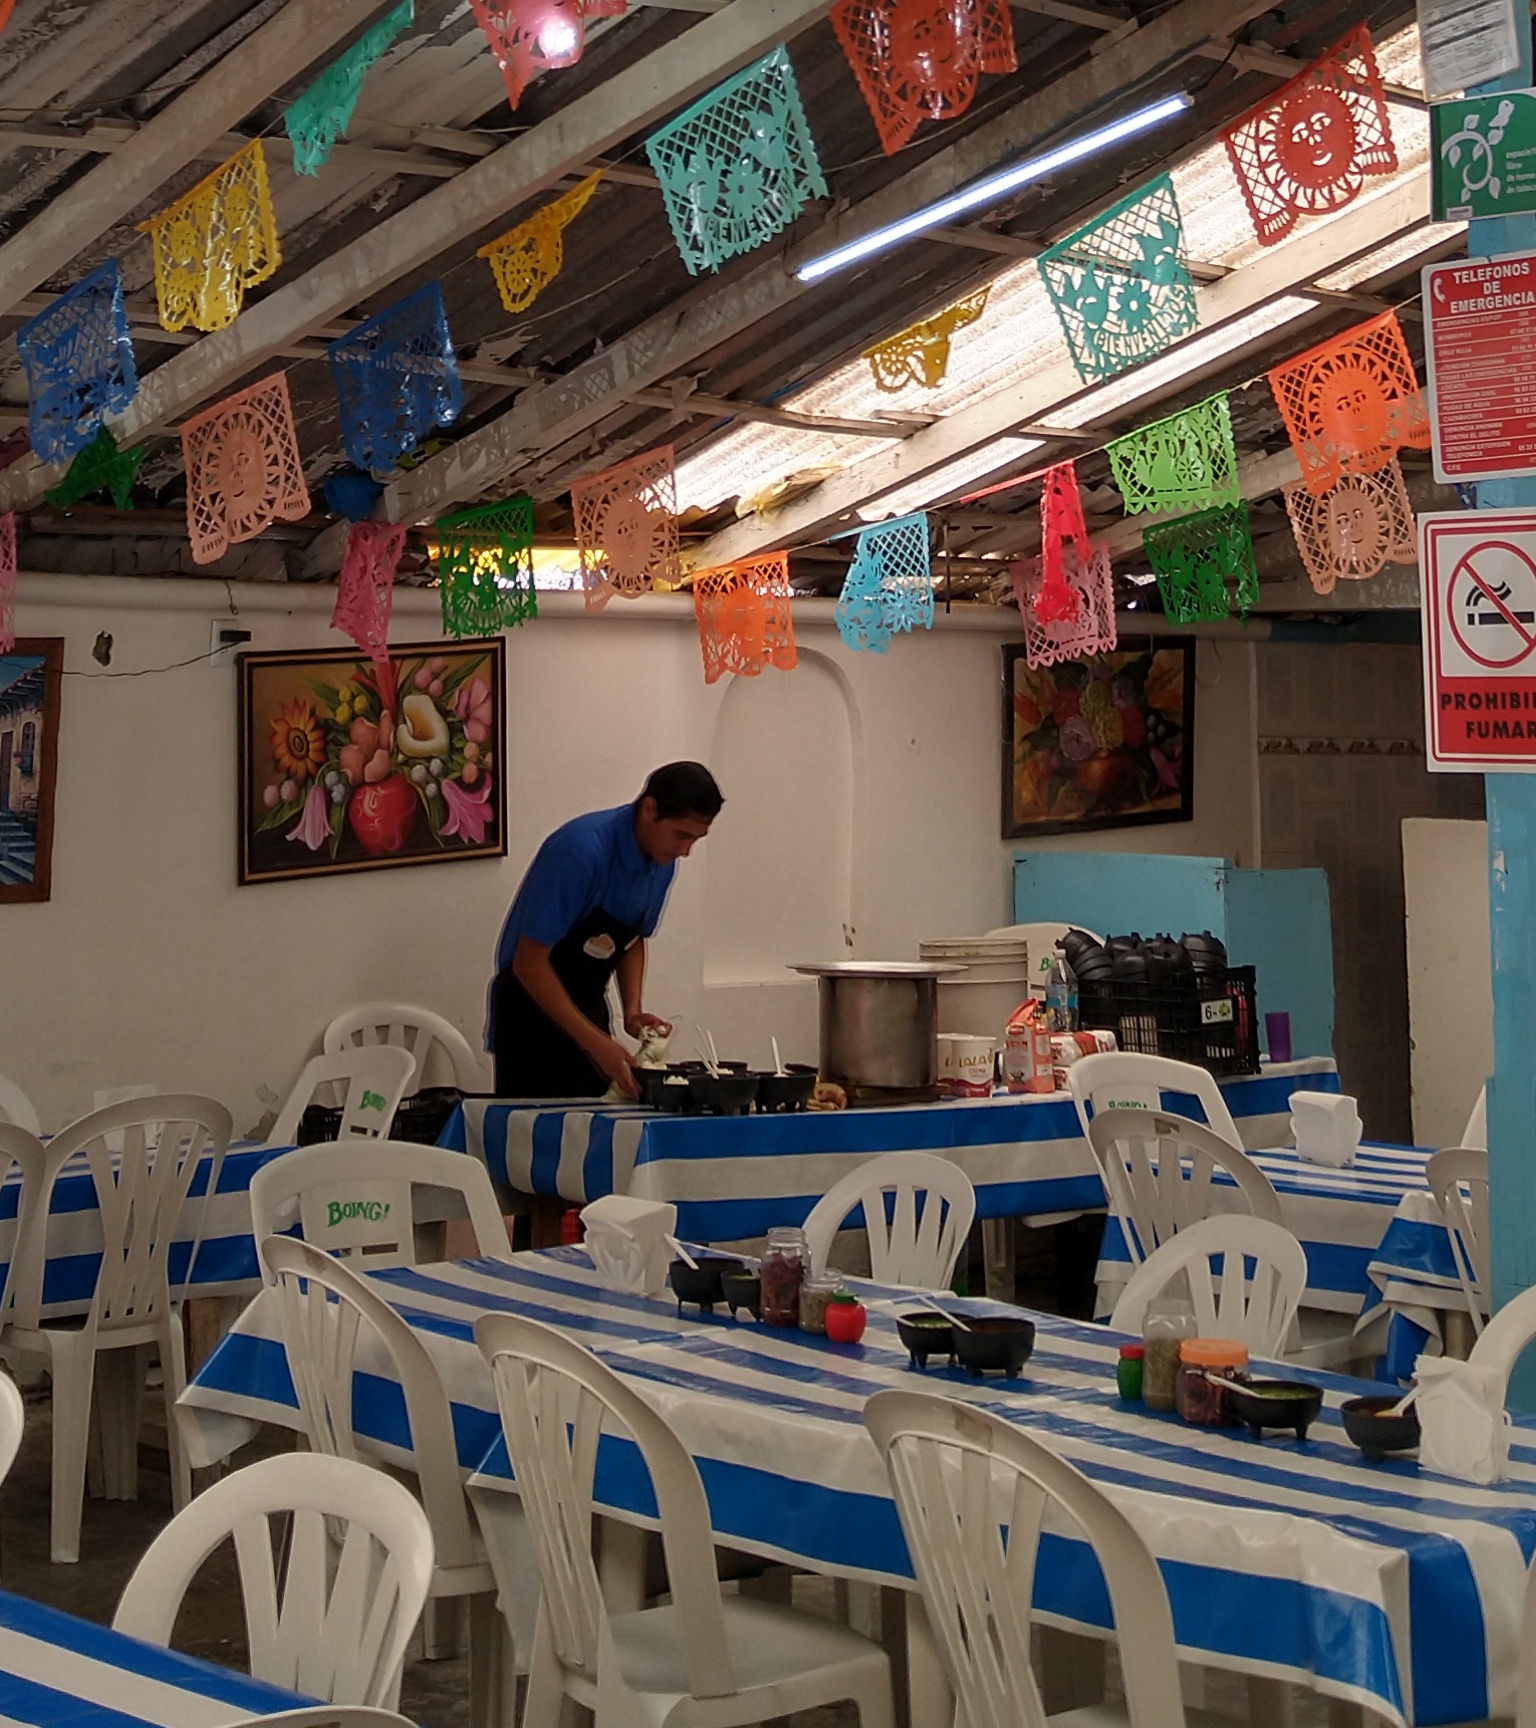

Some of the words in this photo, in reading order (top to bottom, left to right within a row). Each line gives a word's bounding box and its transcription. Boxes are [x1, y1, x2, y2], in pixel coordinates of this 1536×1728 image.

[1453, 262, 1530, 284] TELEFONOS
[1483, 281, 1501, 294] DE
[1450, 291, 1536, 313] EMERGENCIA
[327, 1200, 391, 1229] BOING!
